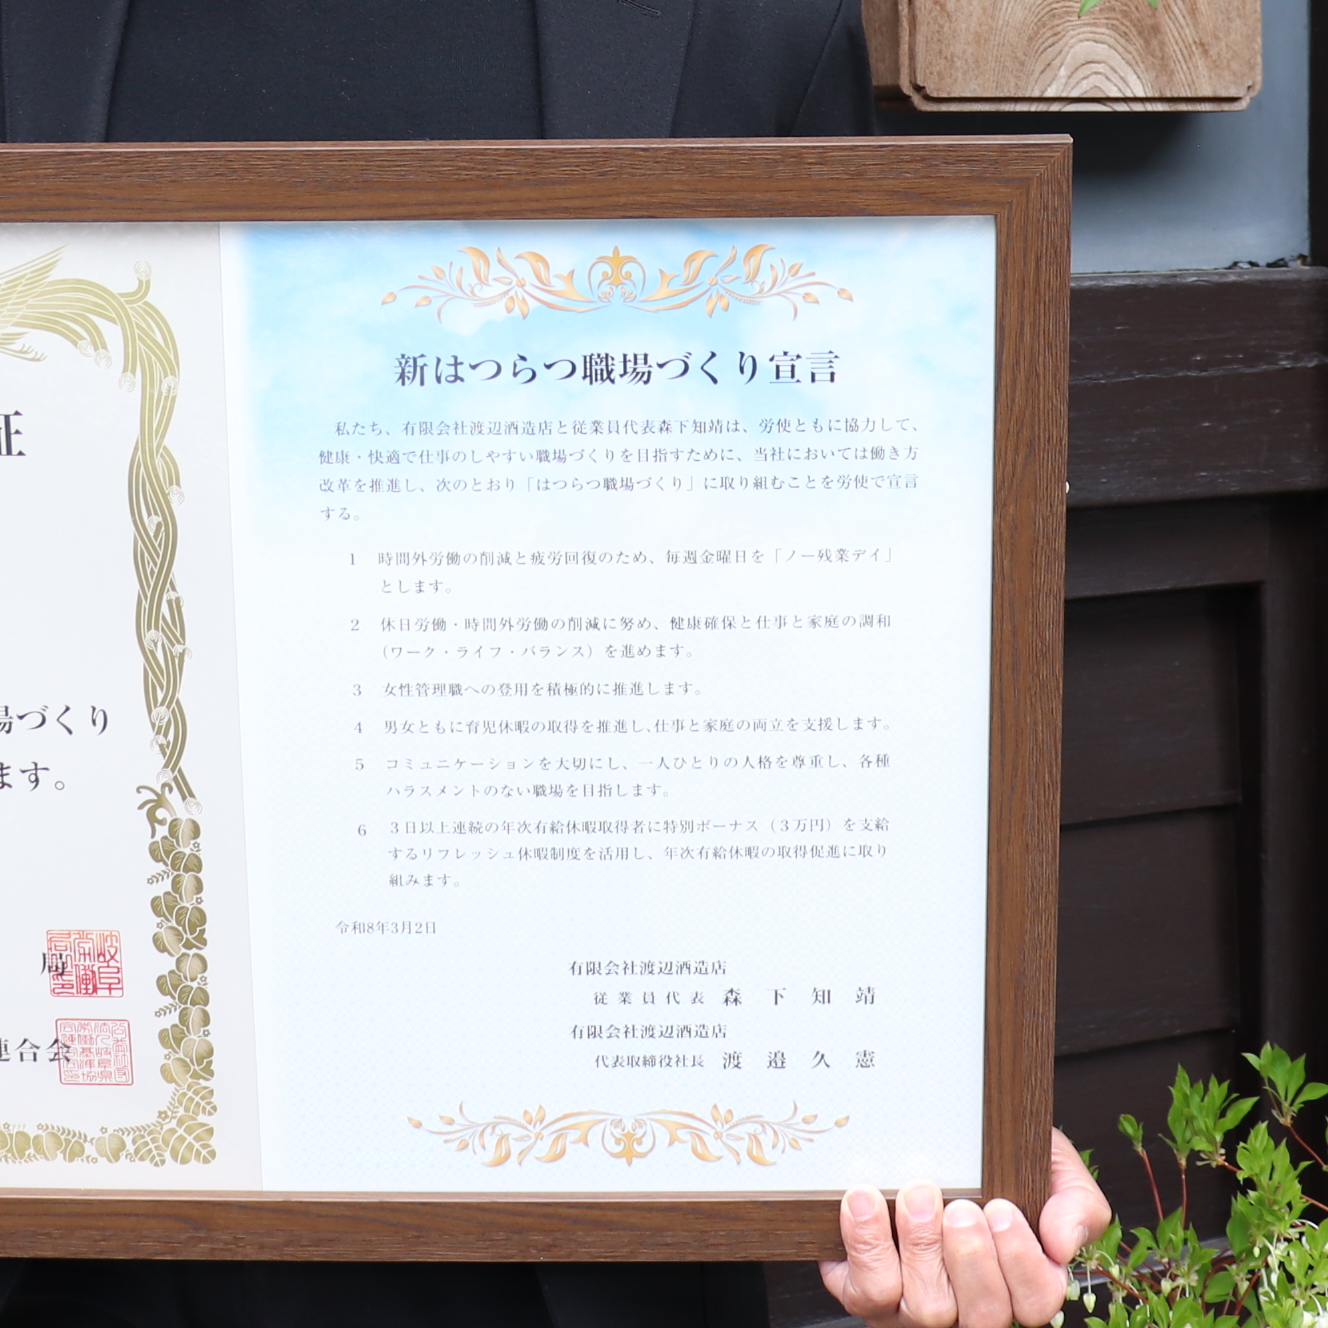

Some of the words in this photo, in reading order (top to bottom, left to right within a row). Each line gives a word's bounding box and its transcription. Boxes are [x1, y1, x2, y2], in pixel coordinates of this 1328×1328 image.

[393, 349, 841, 388] 新はつらつ職場づくり宣言
[320, 506, 360, 522] する。
[381, 578, 452, 595] とします。
[350, 618, 360, 632] 2
[352, 683, 362, 697] 3
[384, 680, 701, 698] 女性管理職への登用を積極的に推進します。
[353, 721, 363, 734] 4
[355, 758, 365, 771] 5
[386, 782, 669, 799] ハラスメントのない職場を目指します。
[357, 823, 367, 837] 6
[388, 872, 460, 888] 組みます。
[335, 920, 436, 936] 令和8年3月2日
[568, 959, 727, 977] 有限会社渡辺酒造店
[593, 990, 705, 1006] 従業員代表
[721, 985, 876, 1008] 森下知靖
[569, 1022, 728, 1041] 有限会社渡辺酒造店
[594, 1053, 705, 1069] 代表取締役社長
